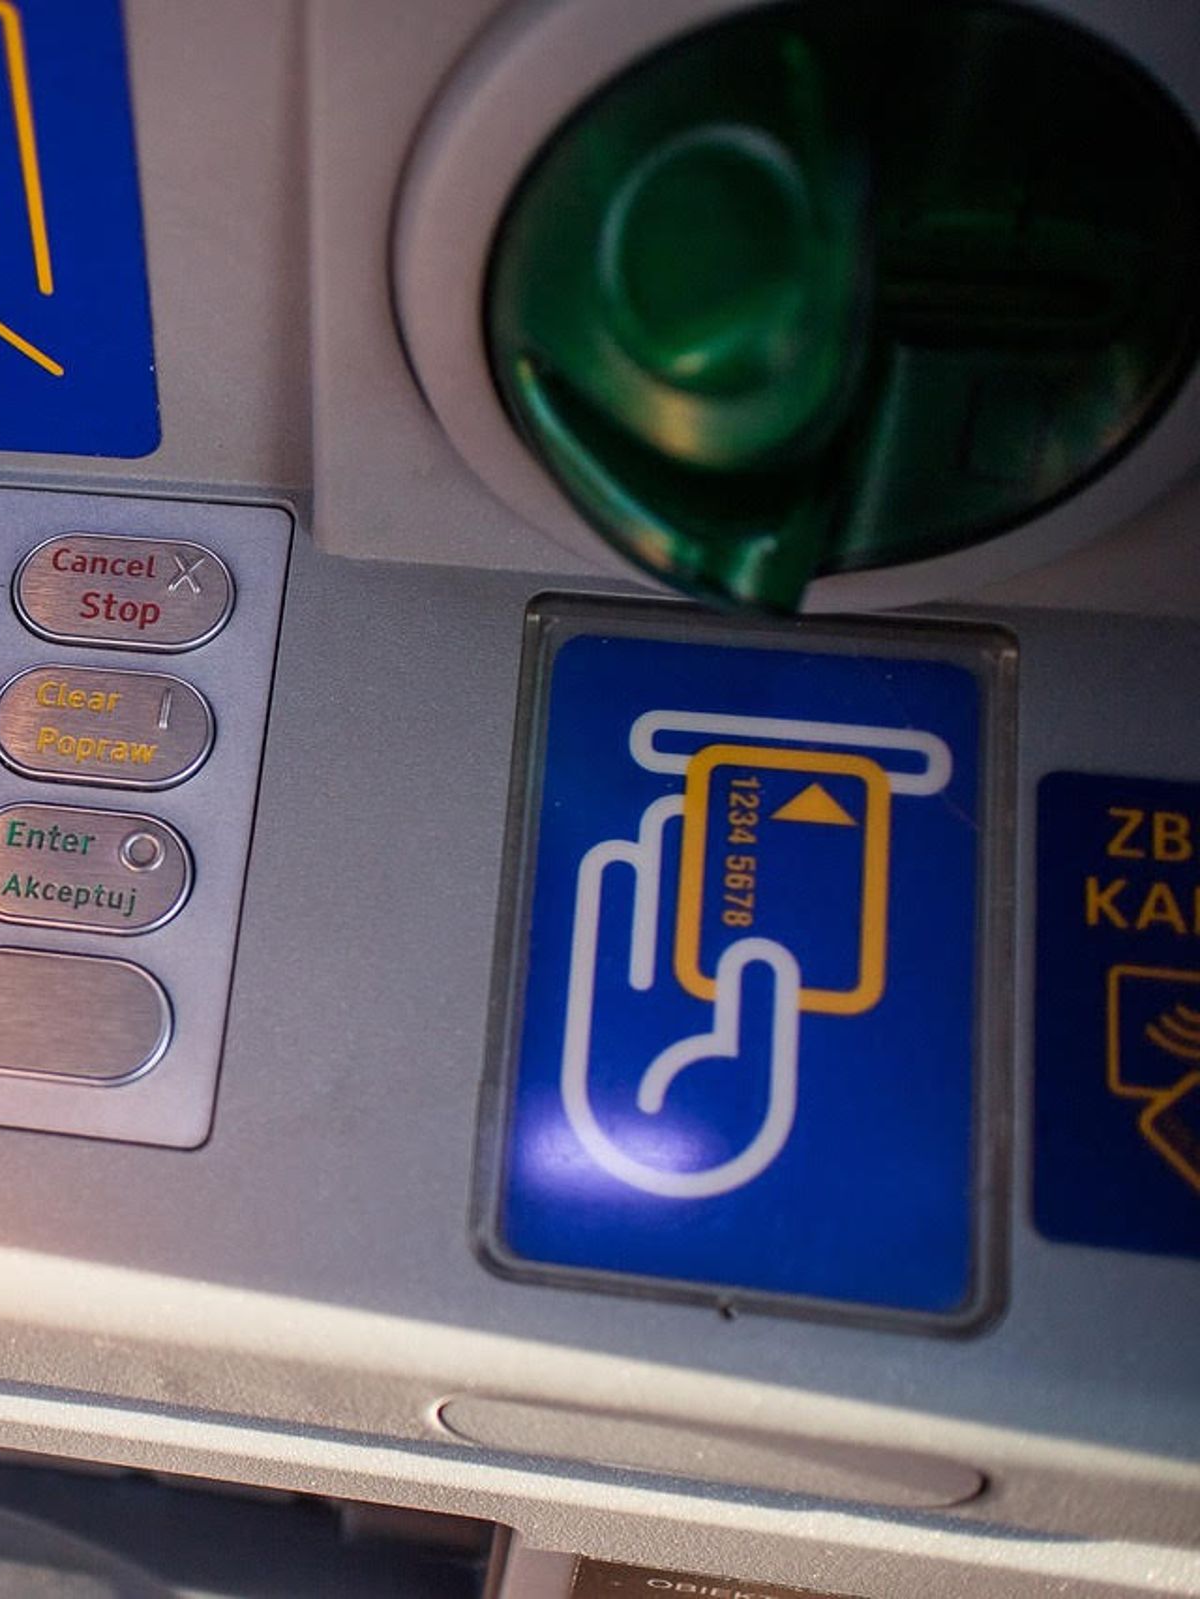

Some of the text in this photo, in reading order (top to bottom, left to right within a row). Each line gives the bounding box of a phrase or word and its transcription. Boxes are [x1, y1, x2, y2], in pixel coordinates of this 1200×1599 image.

[51, 546, 157, 579] Cancel
[79, 591, 161, 630] Stop
[35, 680, 121, 714] Clear
[35, 727, 160, 767] Popraw
[4, 818, 96, 856] Enter
[722, 776, 762, 928] 1234 5678
[2, 872, 139, 918] Akceptuj
[1085, 874, 1200, 936] KA
